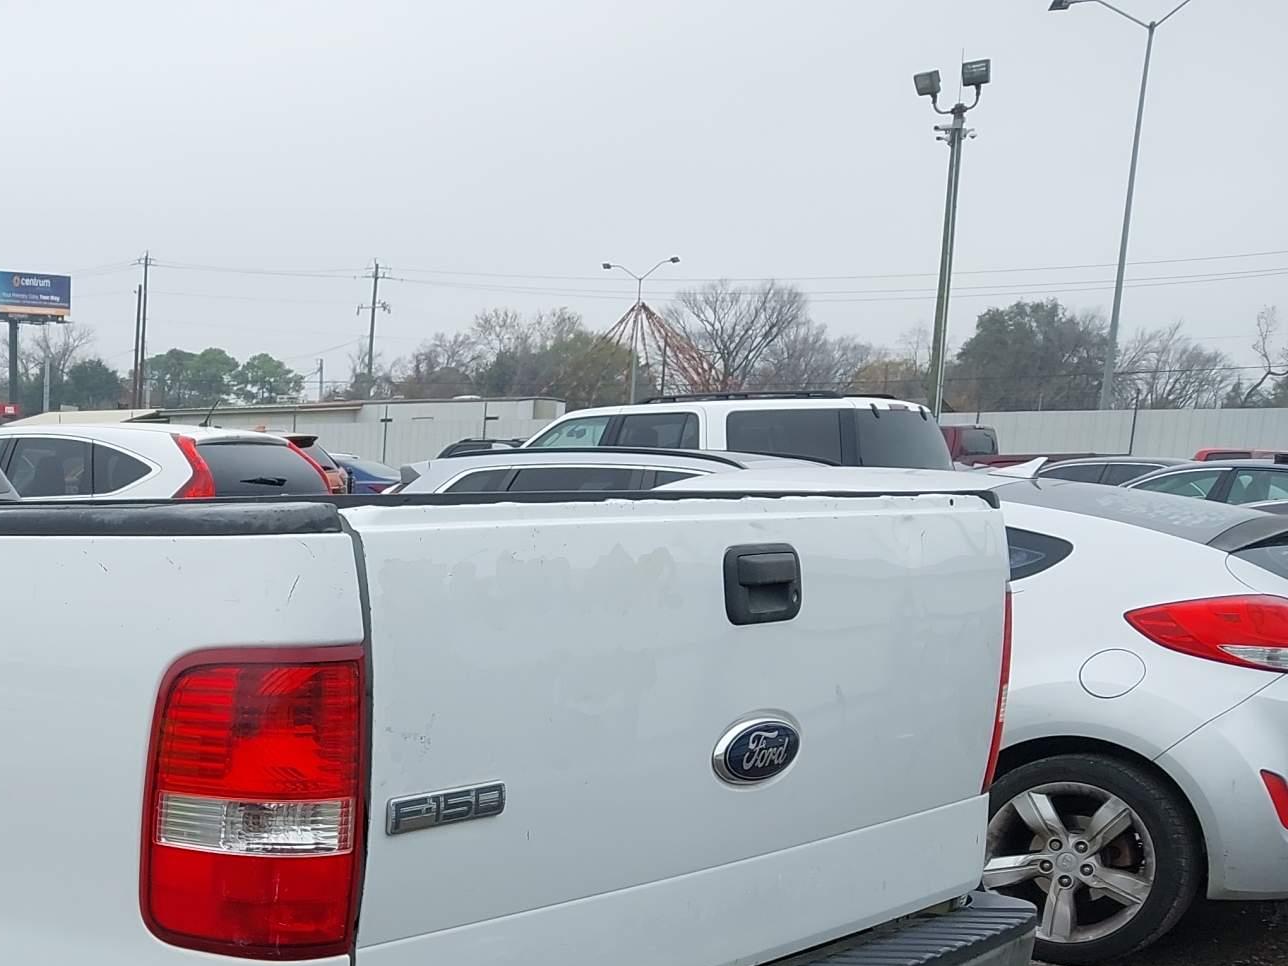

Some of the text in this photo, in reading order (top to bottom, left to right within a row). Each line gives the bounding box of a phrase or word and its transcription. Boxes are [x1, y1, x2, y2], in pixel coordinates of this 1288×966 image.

[20, 276, 51, 287] centrum
[743, 730, 789, 770] Ford
[391, 783, 506, 833] F-150
